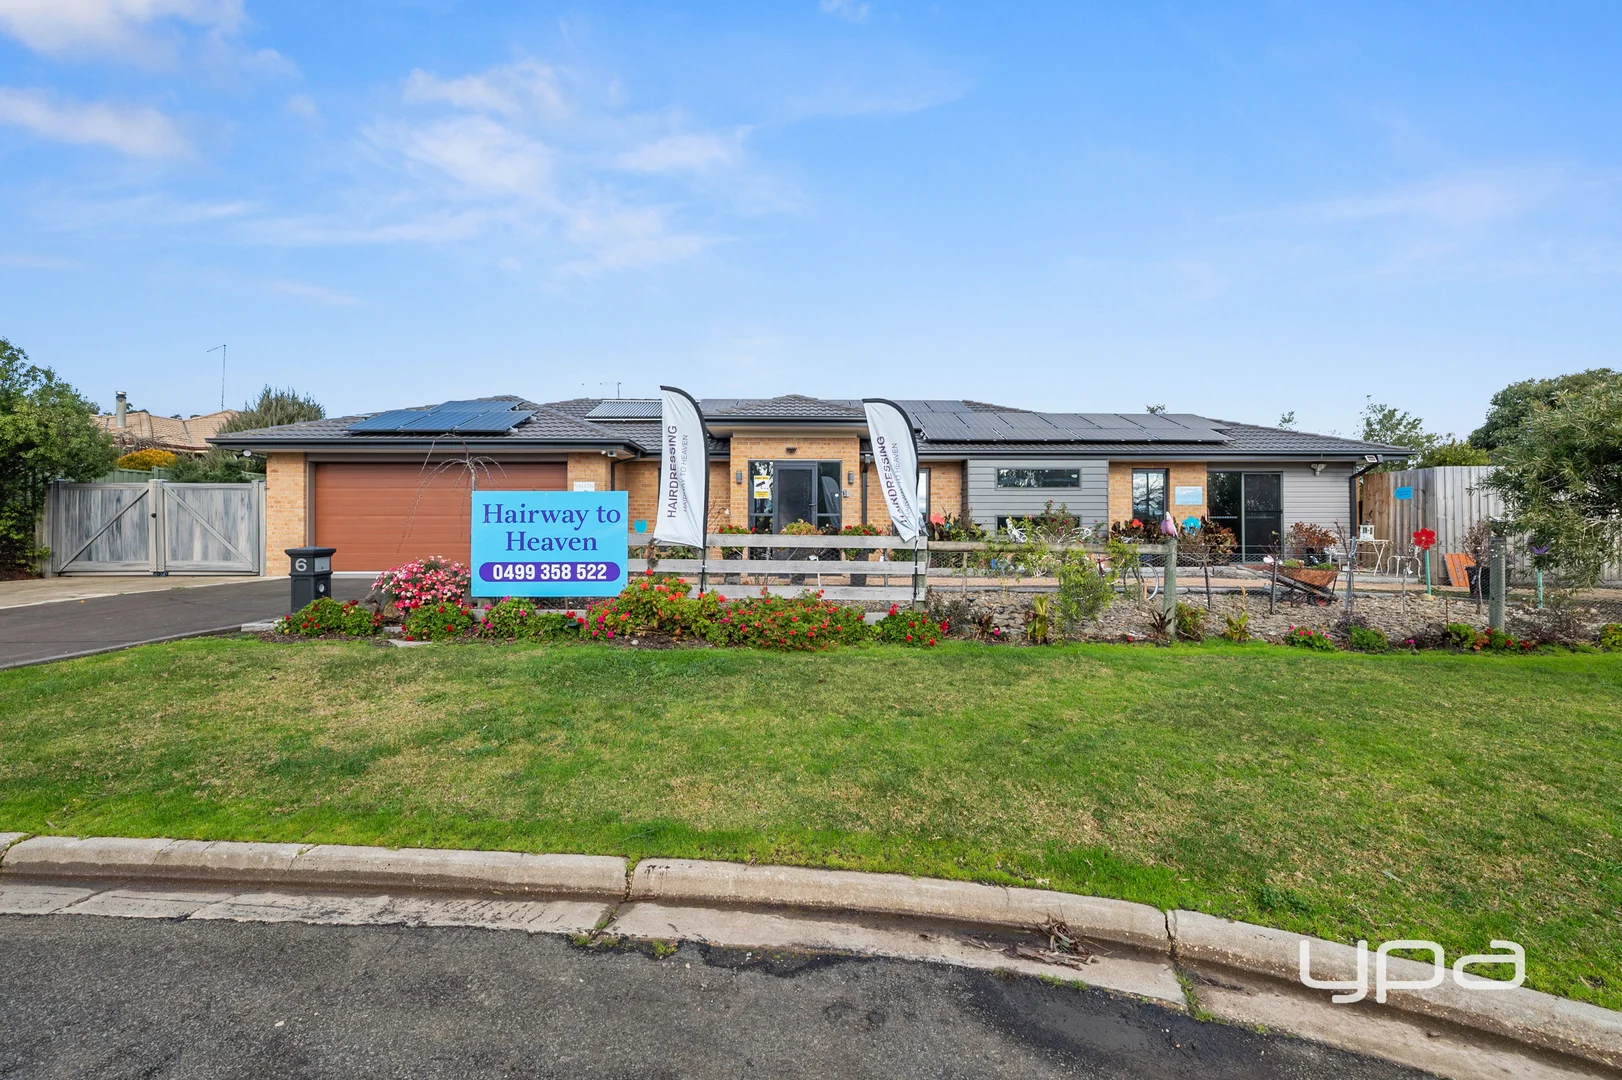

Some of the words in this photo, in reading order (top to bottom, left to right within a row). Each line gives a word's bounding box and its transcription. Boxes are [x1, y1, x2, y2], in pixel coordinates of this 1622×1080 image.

[680, 434, 688, 465] HEAVEN
[891, 443, 899, 473] HEAVEN
[666, 425, 679, 518] HAIRDRESSING
[680, 466, 687, 477] TO
[482, 503, 590, 531] Hairway
[596, 505, 621, 524] to
[505, 531, 598, 551] Heaven
[295, 558, 307, 571] 6
[492, 564, 536, 580] 0499
[540, 564, 572, 580] 358
[576, 564, 607, 580] 522
